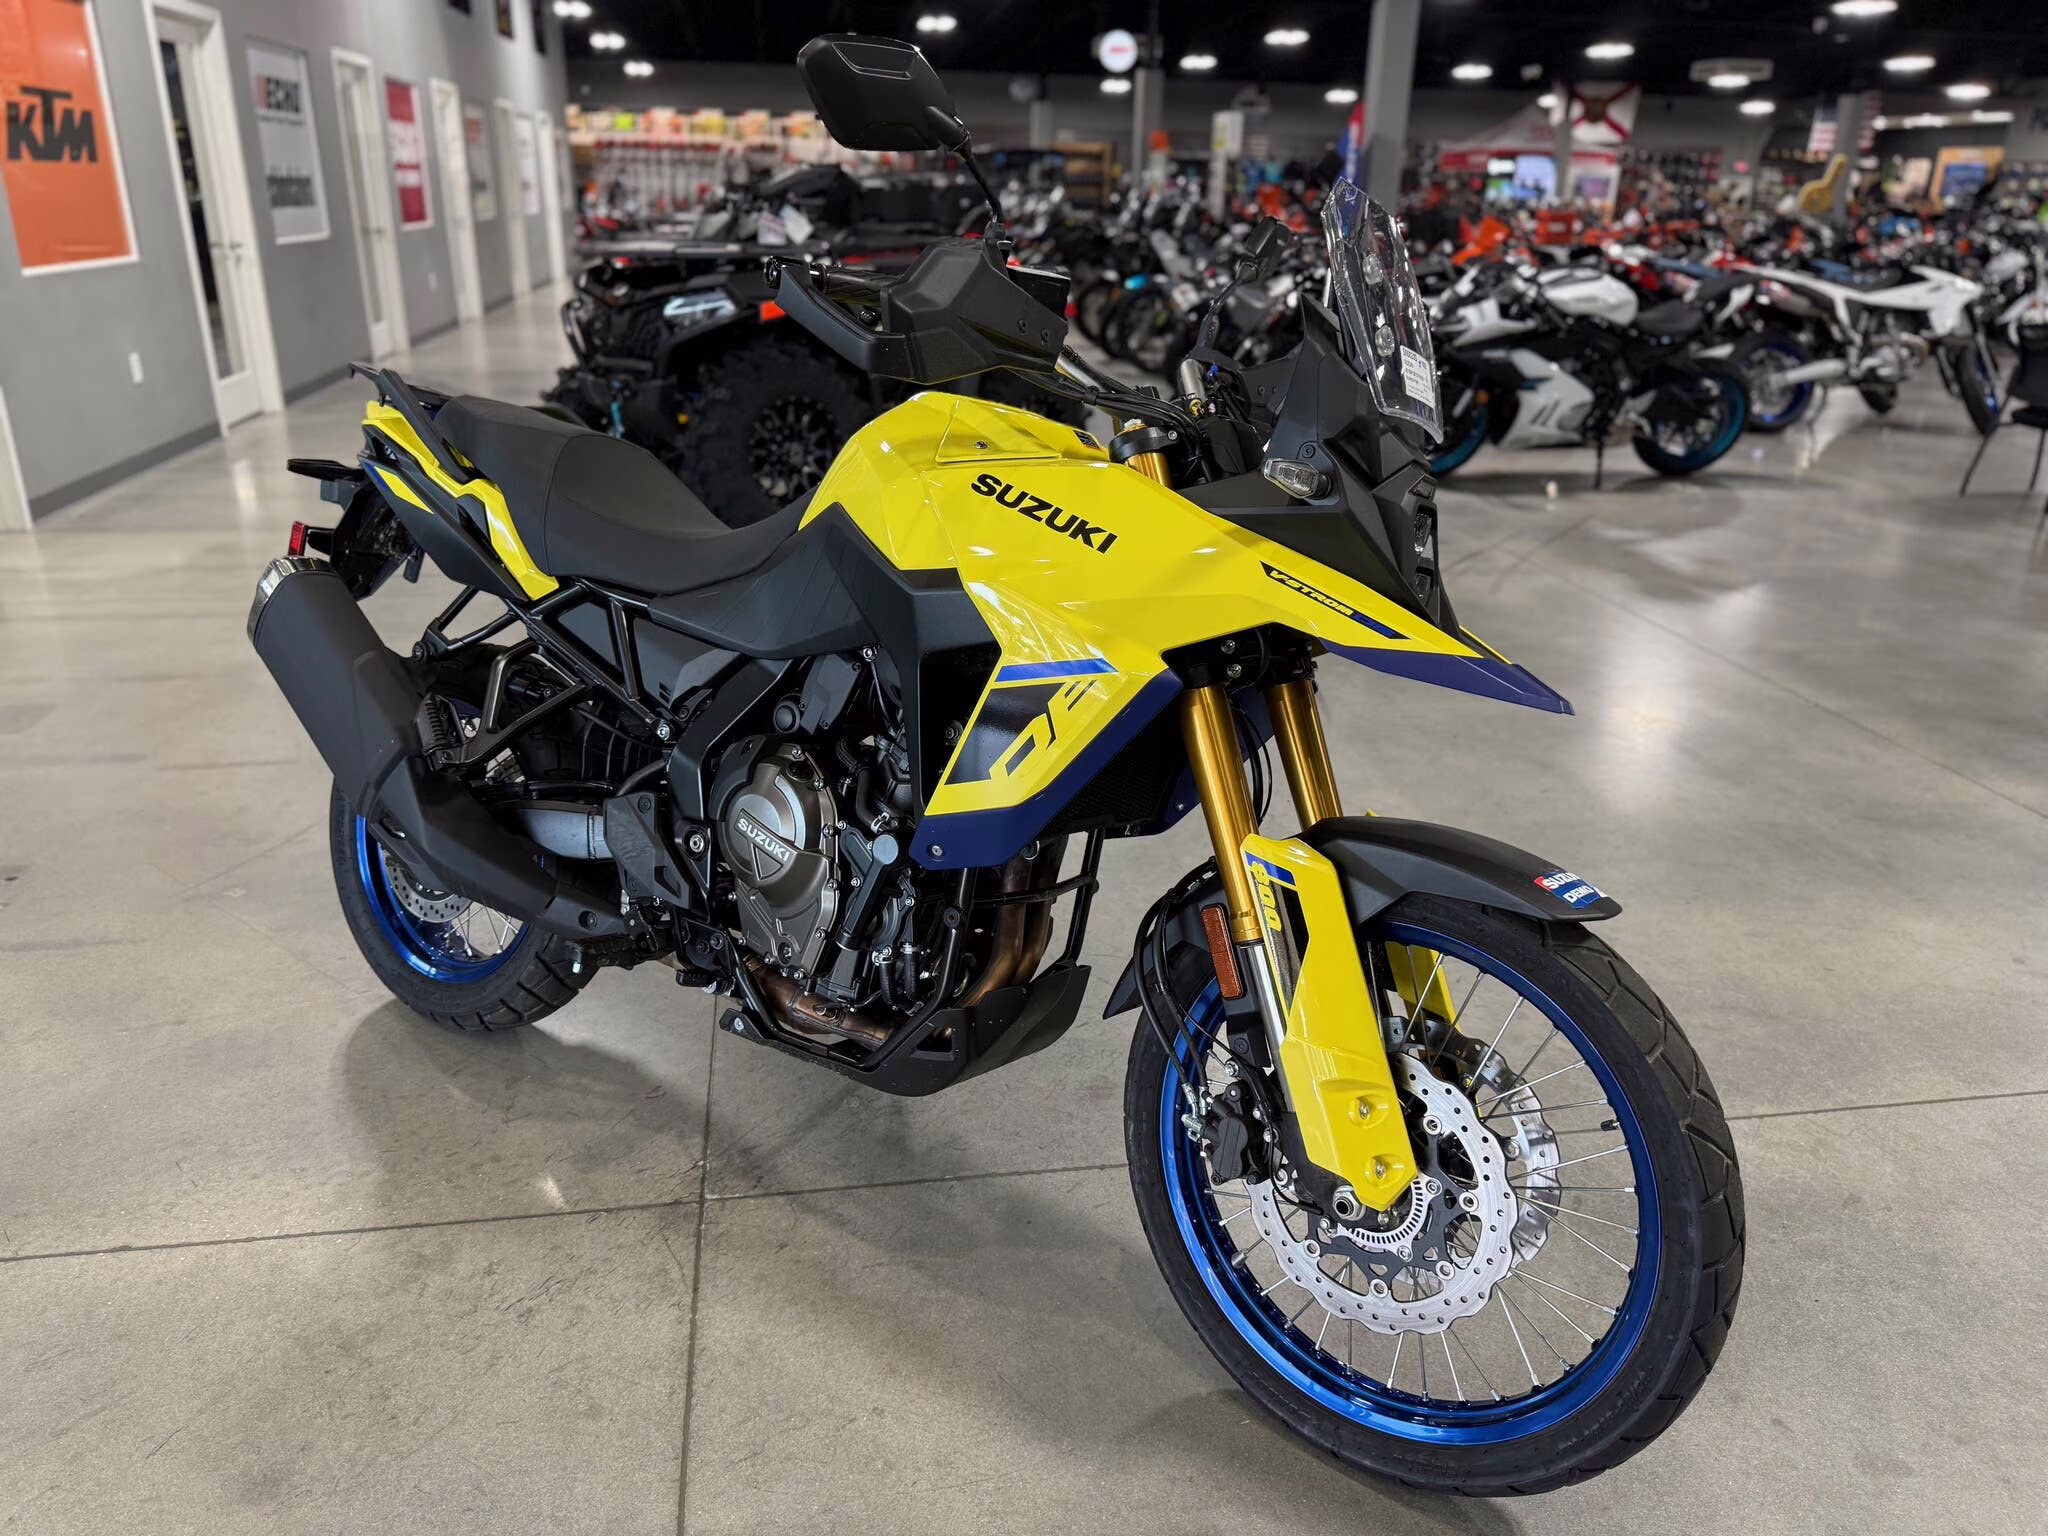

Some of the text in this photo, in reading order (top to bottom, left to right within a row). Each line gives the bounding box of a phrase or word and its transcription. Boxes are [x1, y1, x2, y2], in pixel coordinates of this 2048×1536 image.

[6, 85, 98, 163] KTM
[970, 473, 1118, 554] SUZUKI
[1270, 570, 1354, 615] V-STROM
[738, 818, 790, 862] SUZUKI
[1251, 861, 1282, 932] 800
